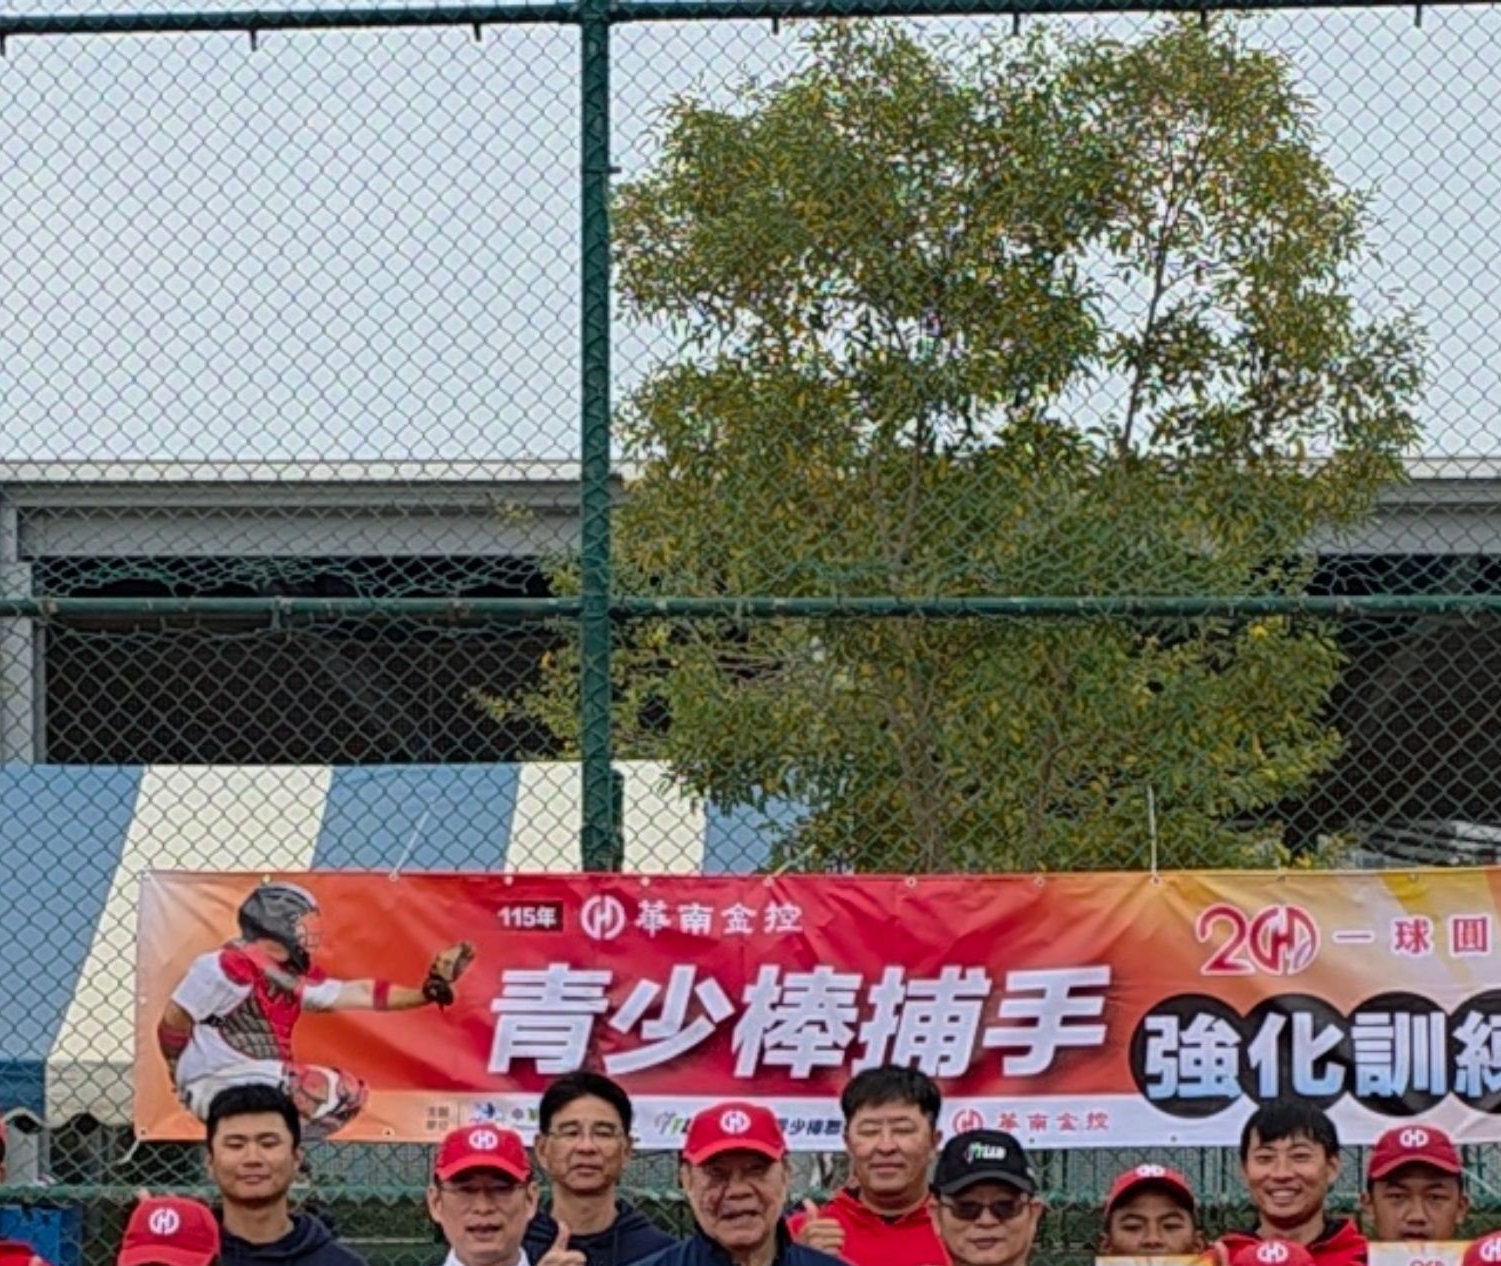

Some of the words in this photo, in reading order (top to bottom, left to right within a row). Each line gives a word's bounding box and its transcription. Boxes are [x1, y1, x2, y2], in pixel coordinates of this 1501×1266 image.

[498, 905, 557, 930] 115年
[634, 899, 804, 938] 華南金控
[486, 962, 1113, 1080] 青少棒捕手
[998, 1110, 1110, 1132] 華南金控
